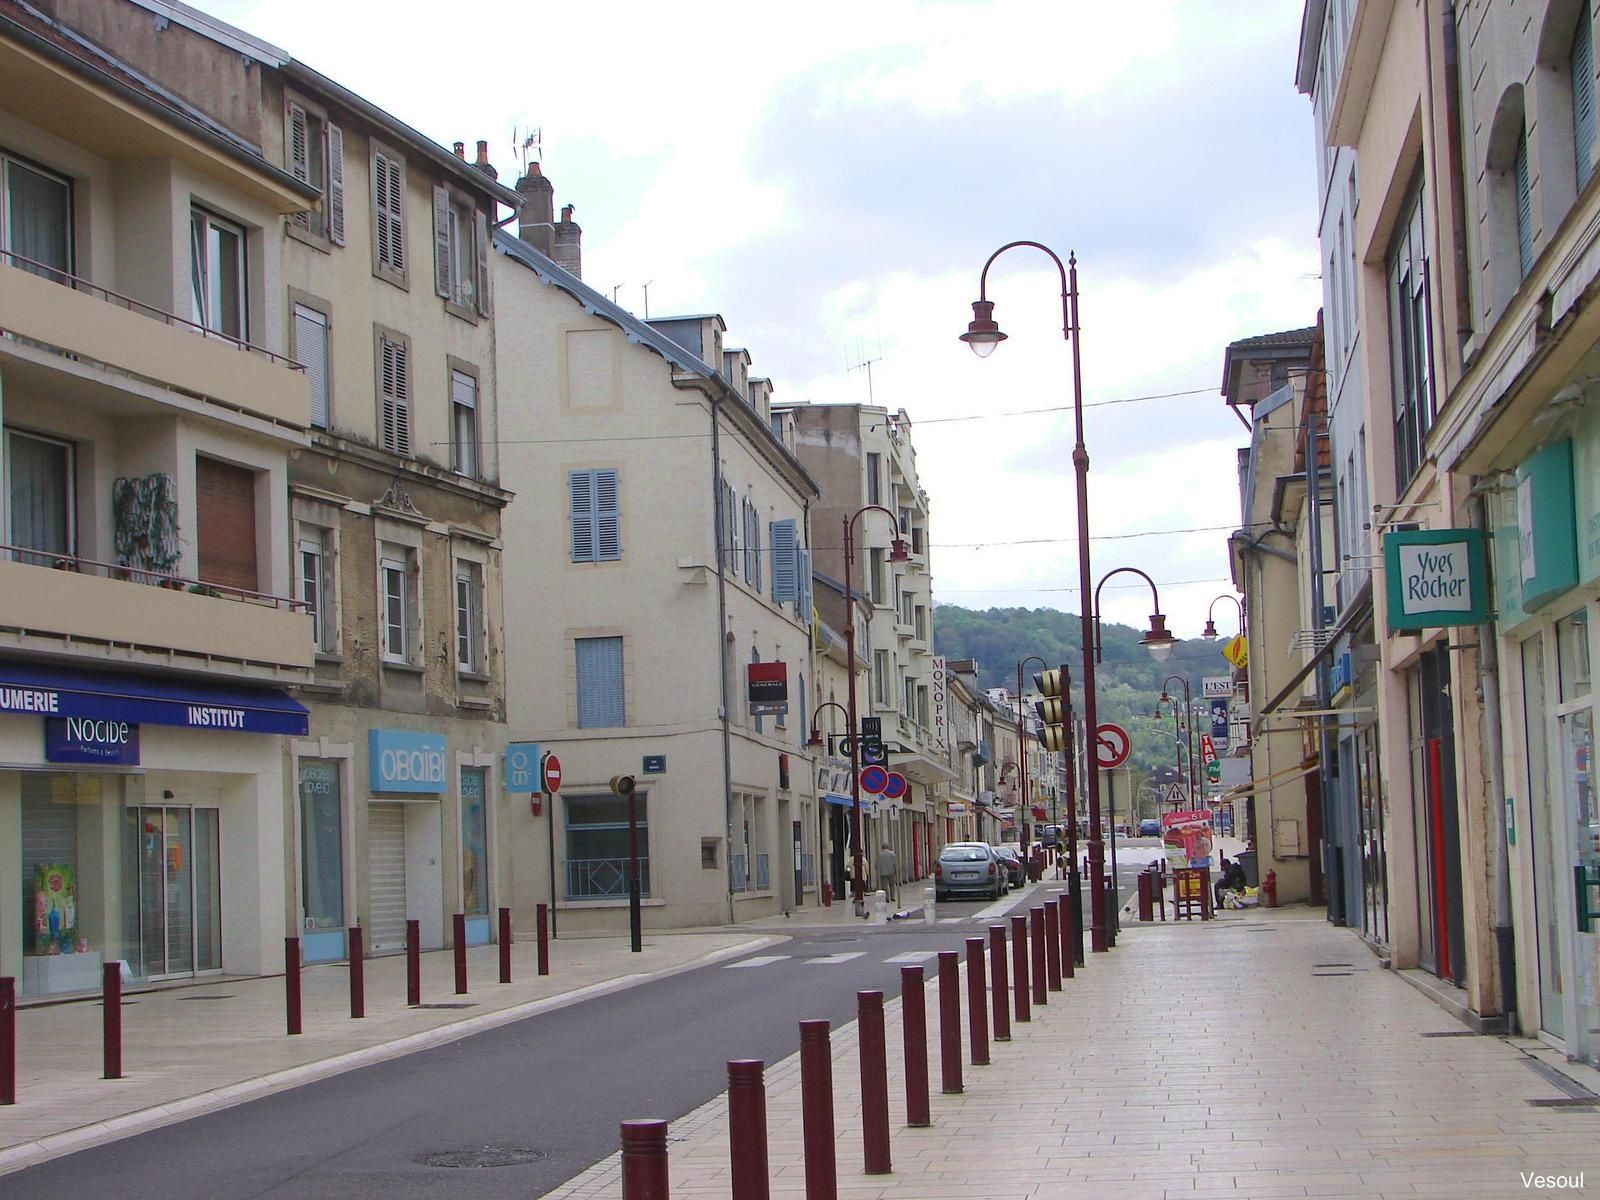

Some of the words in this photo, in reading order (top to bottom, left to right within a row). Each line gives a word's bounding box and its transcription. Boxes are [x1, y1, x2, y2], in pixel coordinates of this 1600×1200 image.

[1417, 551, 1454, 580] Yves
[1408, 574, 1467, 602] Rocher
[0, 687, 59, 713] UMERIE
[932, 658, 946, 750] MONOPRIX
[188, 706, 245, 729] INSTITUT
